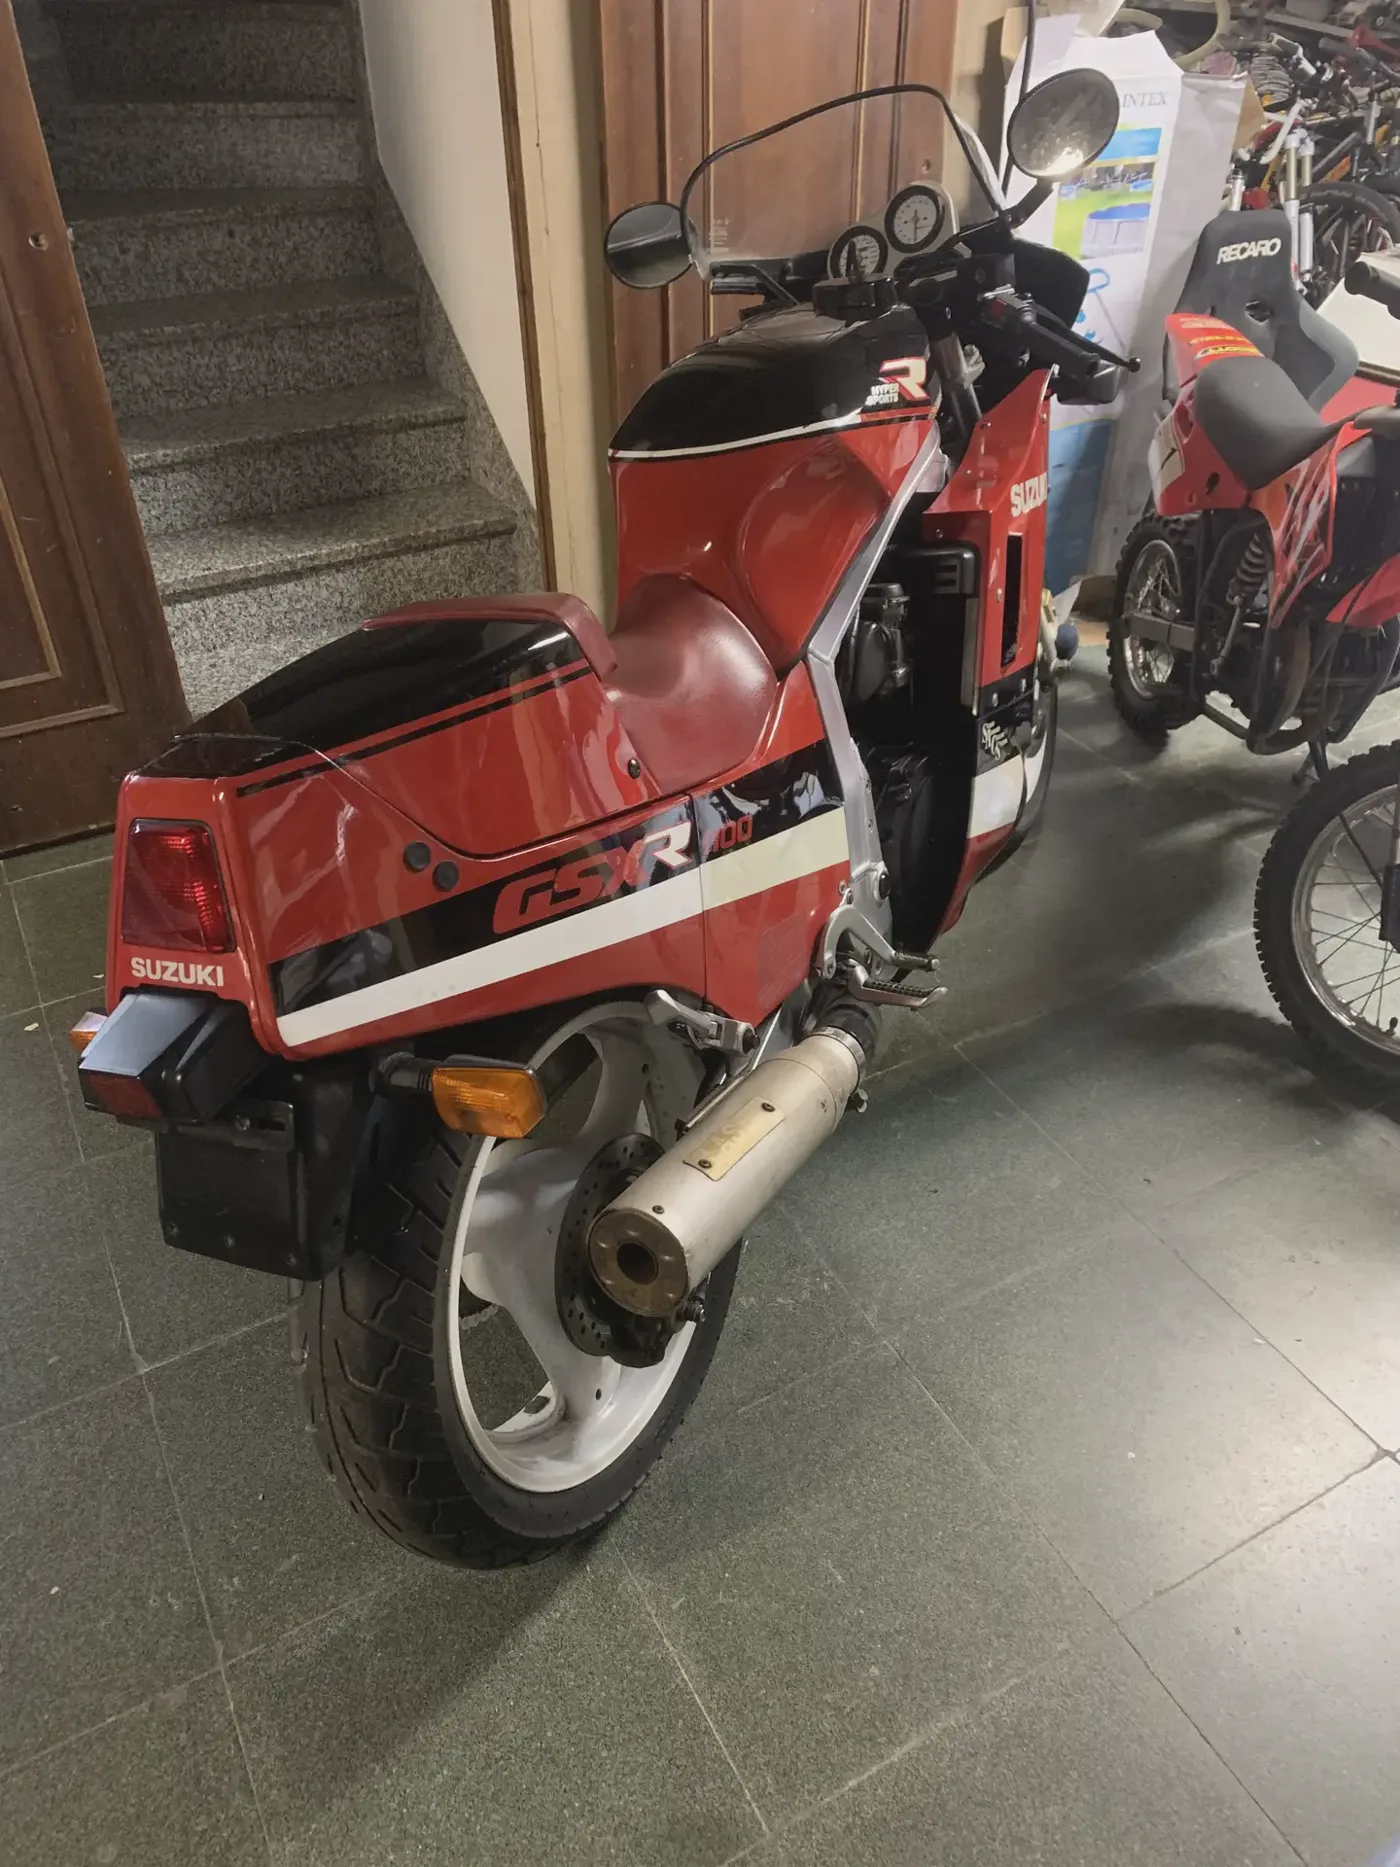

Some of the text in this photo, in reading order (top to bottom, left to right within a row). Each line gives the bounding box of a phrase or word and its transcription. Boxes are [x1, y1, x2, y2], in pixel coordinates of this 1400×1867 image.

[1216, 238, 1281, 264] RECARO
[879, 356, 930, 401] R
[1010, 471, 1048, 518] SUZU
[130, 956, 225, 987] SUZUKI
